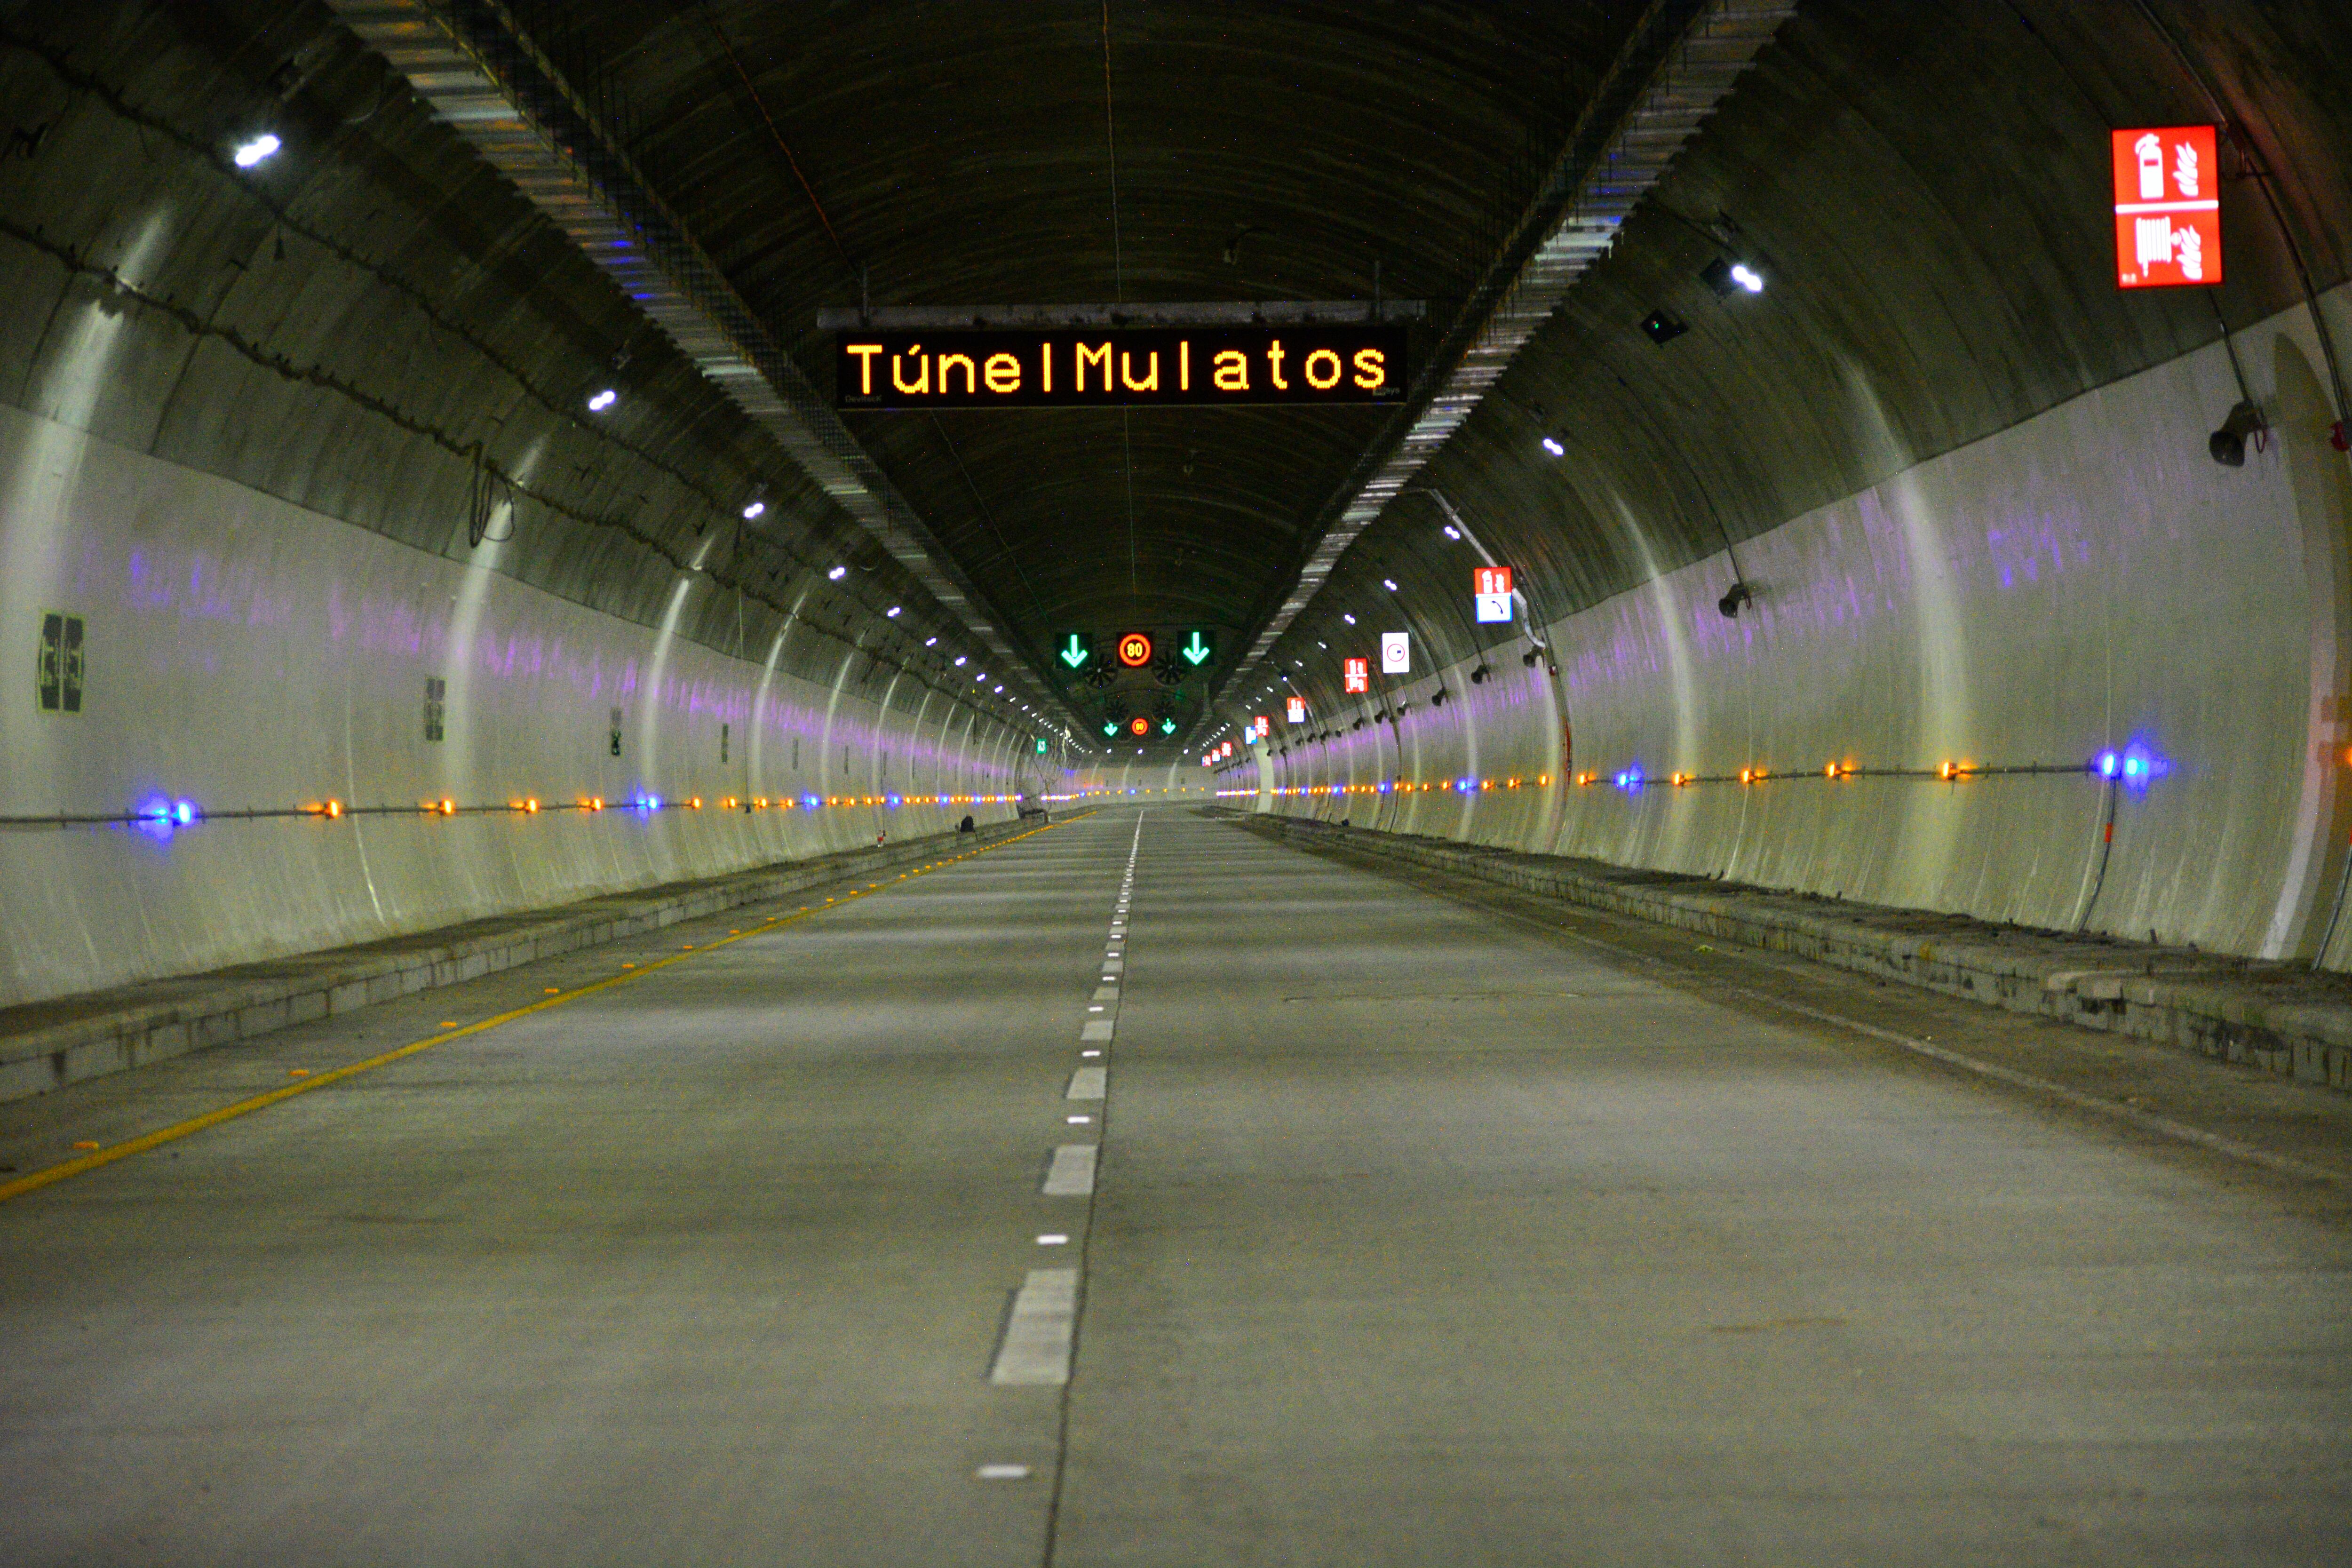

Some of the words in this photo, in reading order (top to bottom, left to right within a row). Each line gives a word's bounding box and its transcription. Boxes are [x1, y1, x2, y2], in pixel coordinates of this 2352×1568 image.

[846, 342, 1052, 395] Túnel
[1075, 340, 1385, 392] Mulatos
[1127, 642, 1143, 657] 80
